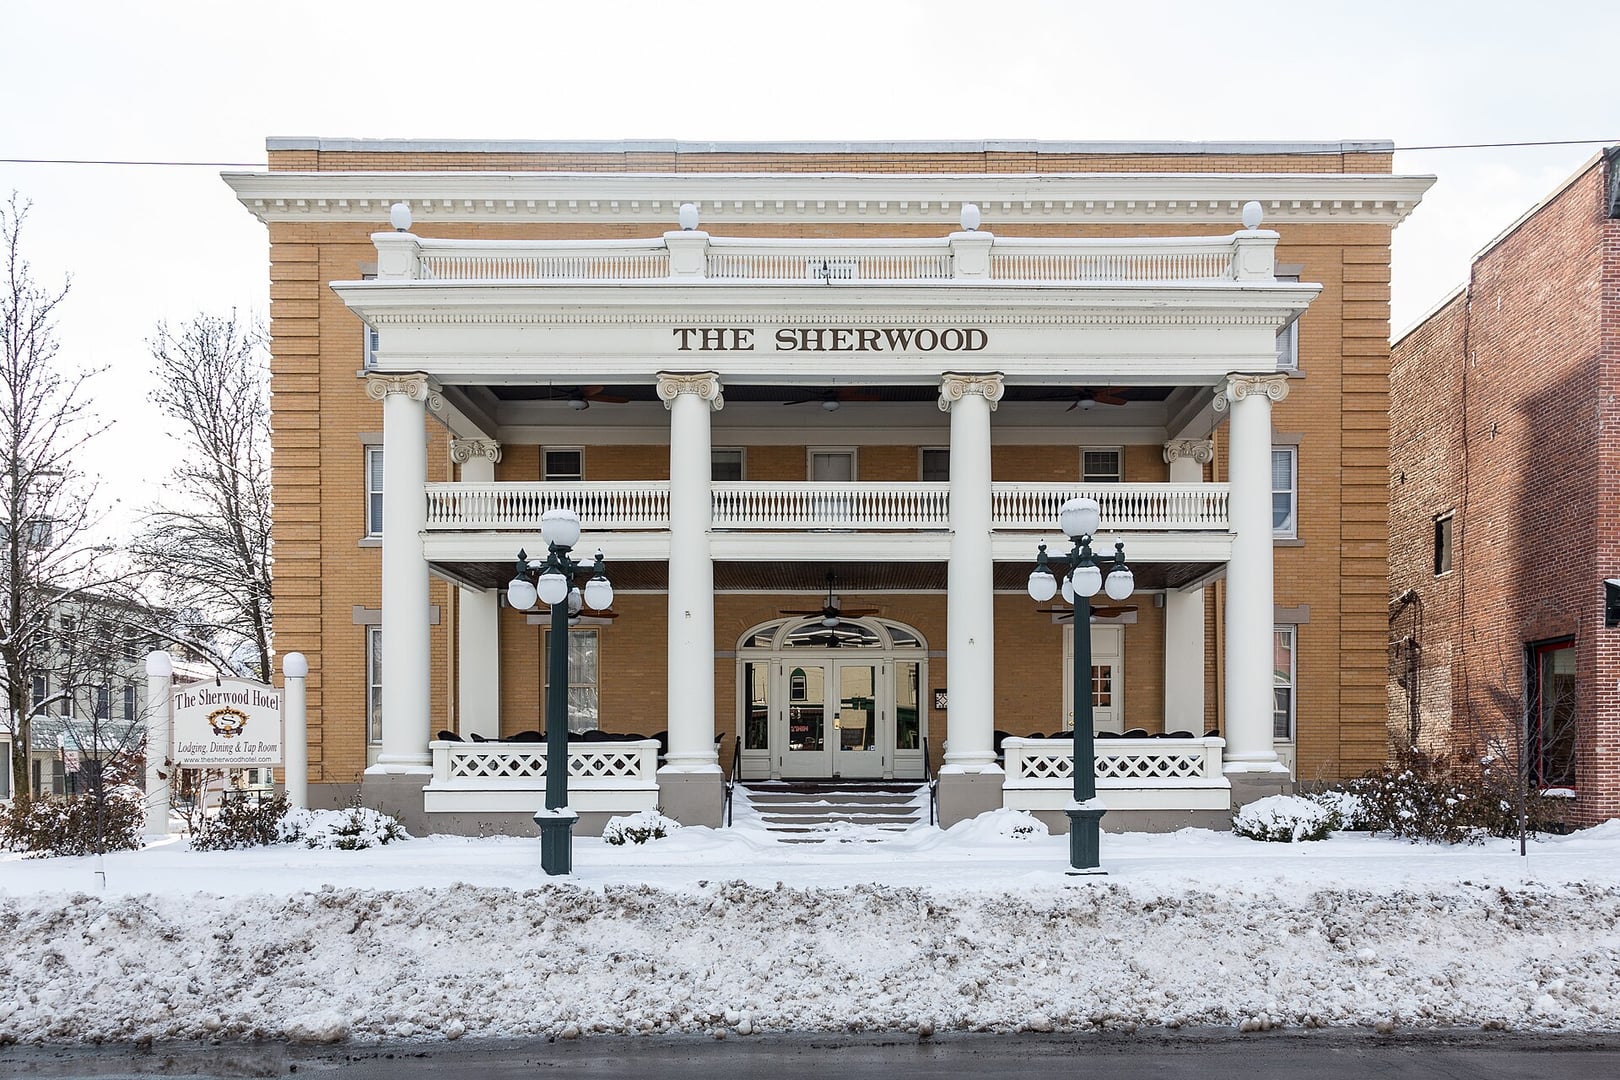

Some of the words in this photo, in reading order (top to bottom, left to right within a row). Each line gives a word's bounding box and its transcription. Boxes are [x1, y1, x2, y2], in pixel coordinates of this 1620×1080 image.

[673, 328, 754, 351] THE
[775, 328, 988, 351] SHERWOOD
[175, 693, 196, 710] The
[199, 688, 249, 706] Sherwood
[252, 689, 279, 711] Hotel
[210, 741, 233, 755] Dining
[234, 742, 242, 753] &
[243, 741, 256, 755] Tap
[257, 741, 277, 753] Room
